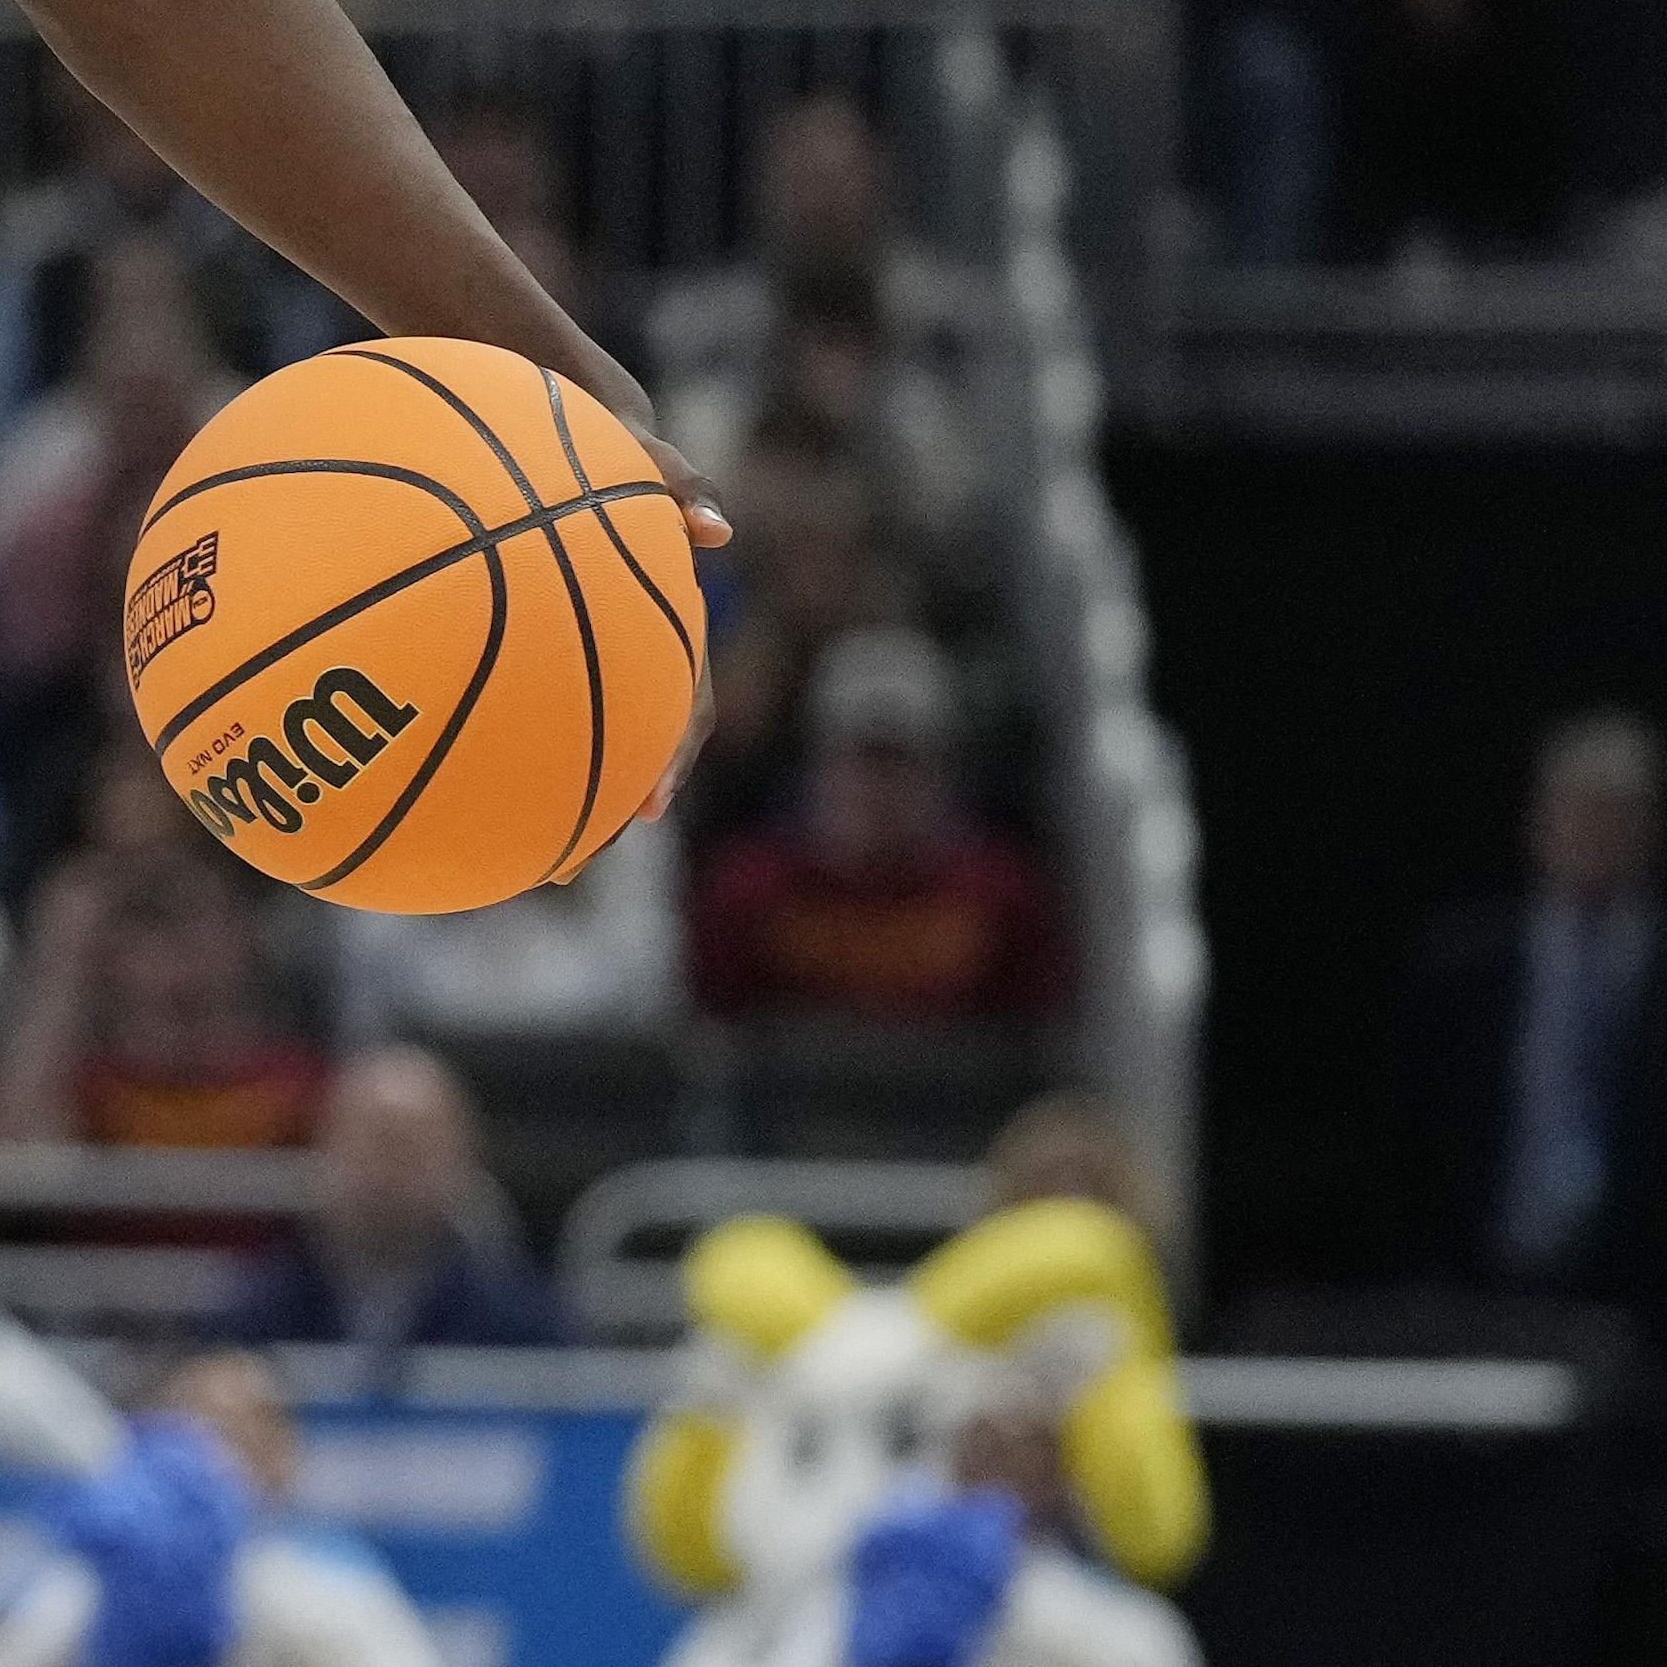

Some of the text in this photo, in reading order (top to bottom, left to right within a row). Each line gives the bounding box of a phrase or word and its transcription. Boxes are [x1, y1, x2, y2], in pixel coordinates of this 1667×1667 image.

[140, 595, 192, 663] MARCH
[188, 721, 246, 775] EVO NXT
[188, 665, 423, 838] Wilso
